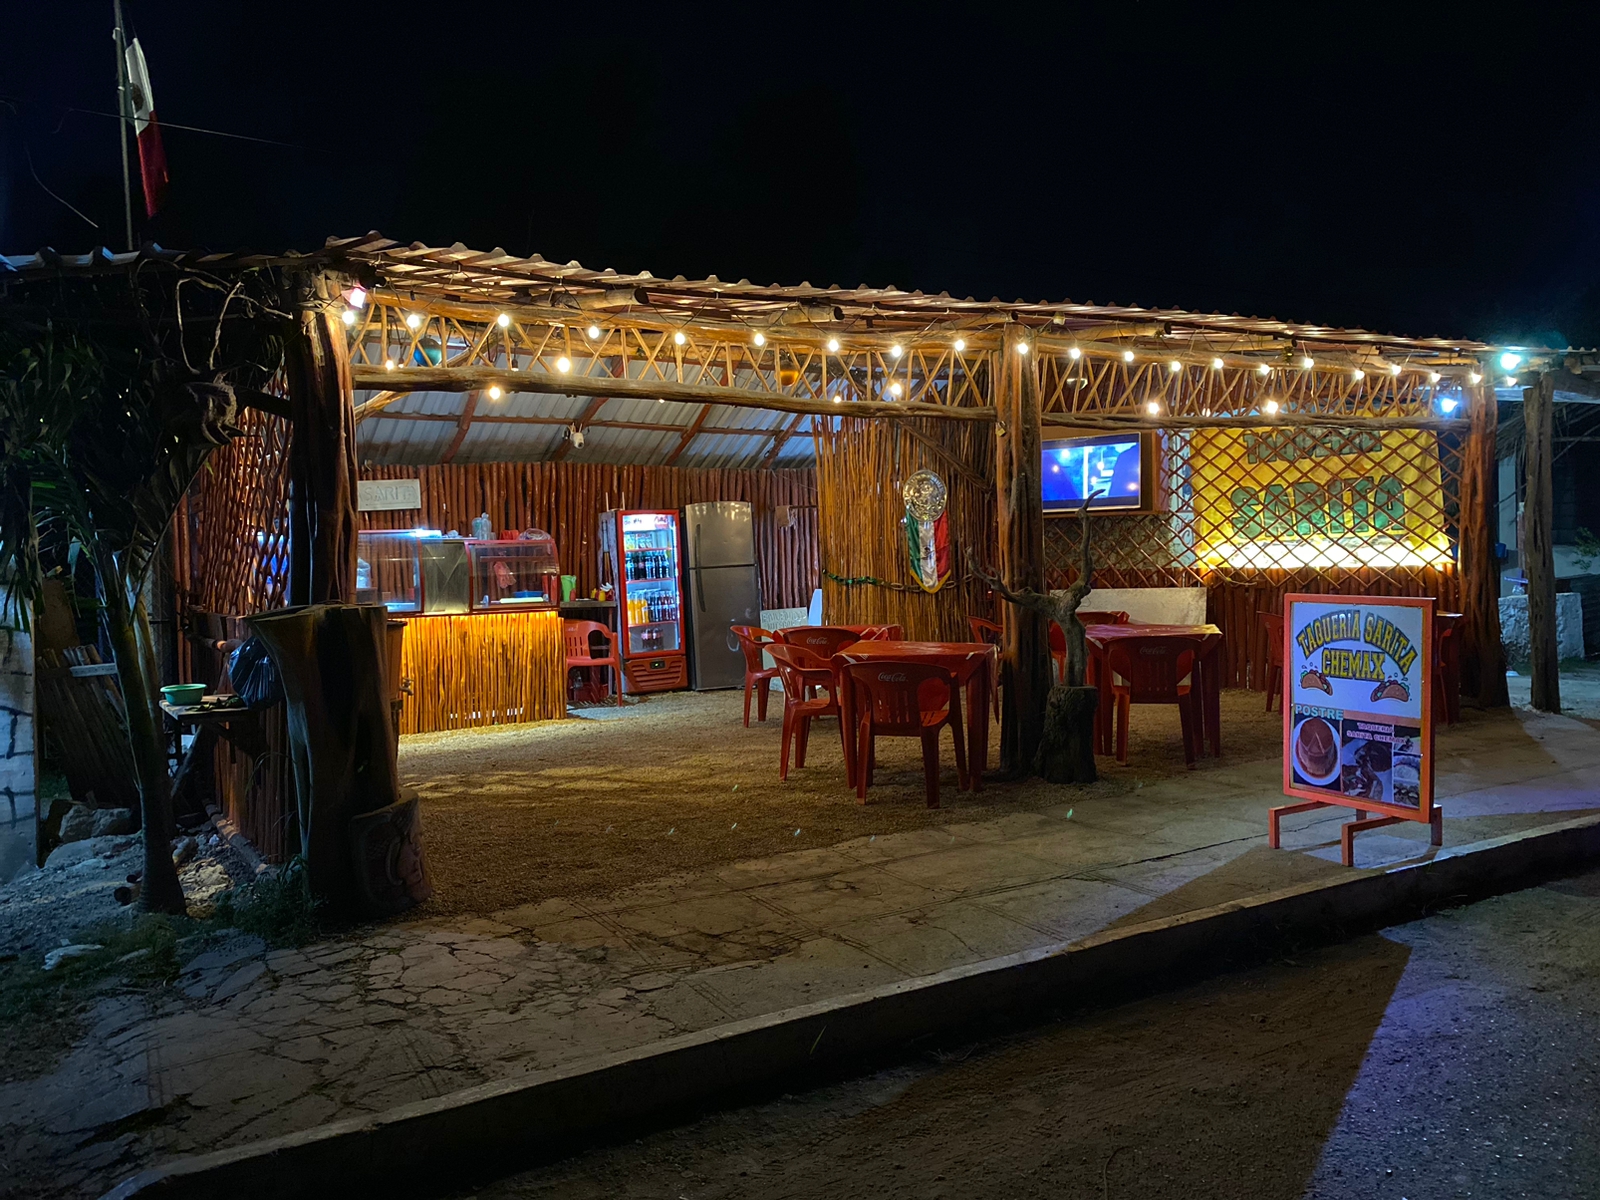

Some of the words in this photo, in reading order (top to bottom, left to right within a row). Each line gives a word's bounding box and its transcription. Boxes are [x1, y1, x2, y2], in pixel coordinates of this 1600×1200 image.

[1231, 475, 1405, 538] SARITA
[1322, 647, 1385, 682] CHEMAX
[1364, 612, 1418, 676] SARITA
[1295, 705, 1344, 720] POSTRE
